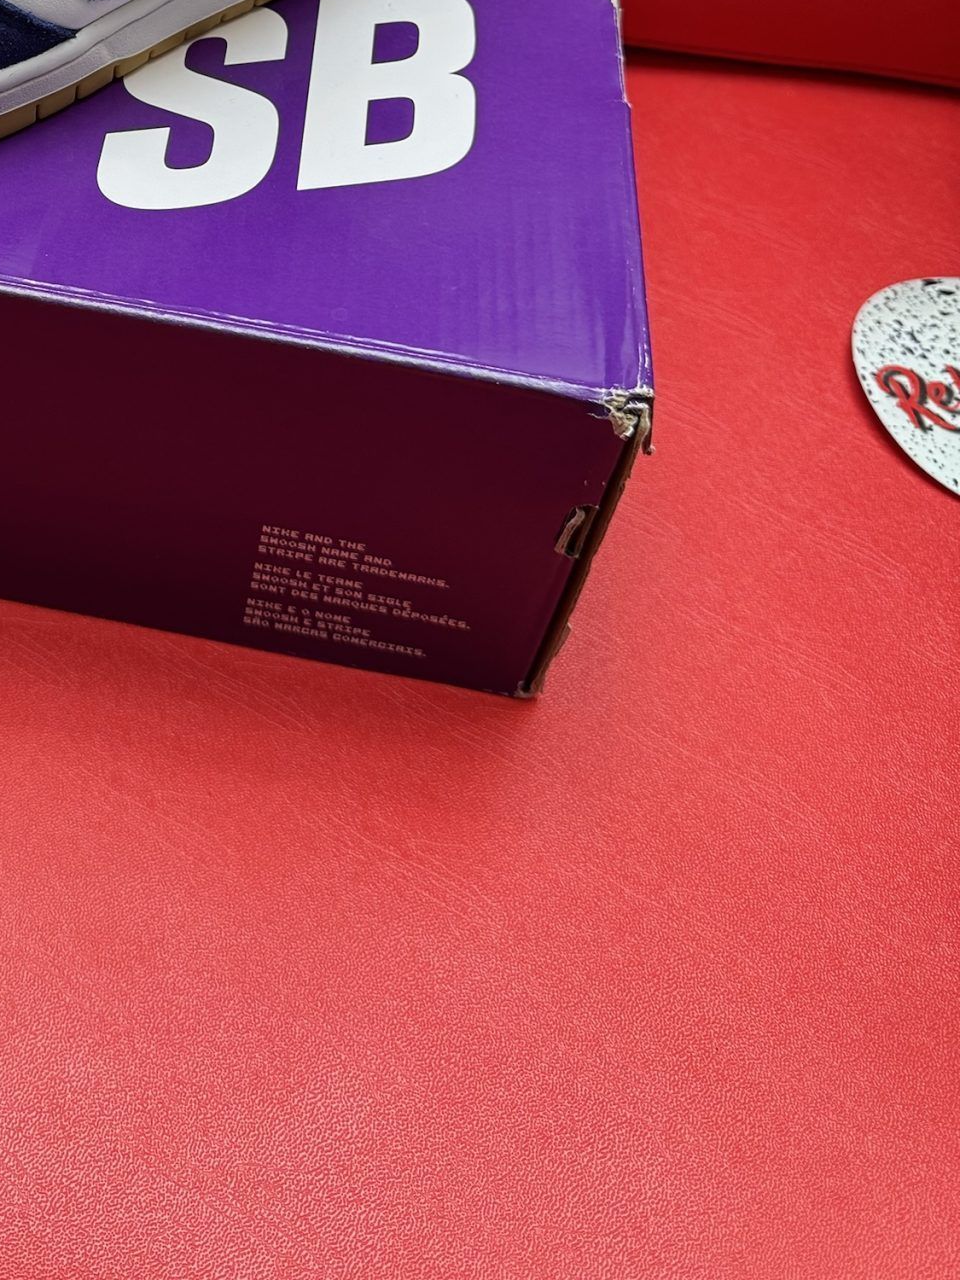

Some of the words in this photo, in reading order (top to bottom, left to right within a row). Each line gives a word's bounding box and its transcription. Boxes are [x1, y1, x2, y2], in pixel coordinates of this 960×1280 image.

[876, 364, 960, 433] Re
[260, 535, 316, 552] SWOOSH
[321, 547, 358, 560] NAME
[364, 555, 392, 567] AND
[262, 525, 300, 539] NIKE
[305, 533, 333, 545] AND
[339, 539, 366, 551] THE
[254, 562, 291, 575] NIKE
[295, 570, 312, 580] LE
[258, 545, 313, 562] STRIPE
[318, 556, 346, 568] ARE
[352, 562, 450, 589] TRADEMARKS.
[250, 581, 286, 594] SONT
[291, 589, 318, 601] DES
[323, 595, 387, 614] MARQUES
[252, 572, 308, 588] SWOOSH
[312, 582, 330, 592] ET
[335, 587, 363, 598] SON
[368, 593, 412, 608] SIGLE
[245, 607, 298, 624] SWOOSH
[317, 620, 371, 637] STRIPE
[247, 597, 283, 610] NIKE
[315, 610, 351, 624] NOME
[275, 622, 328, 639] MARCAS
